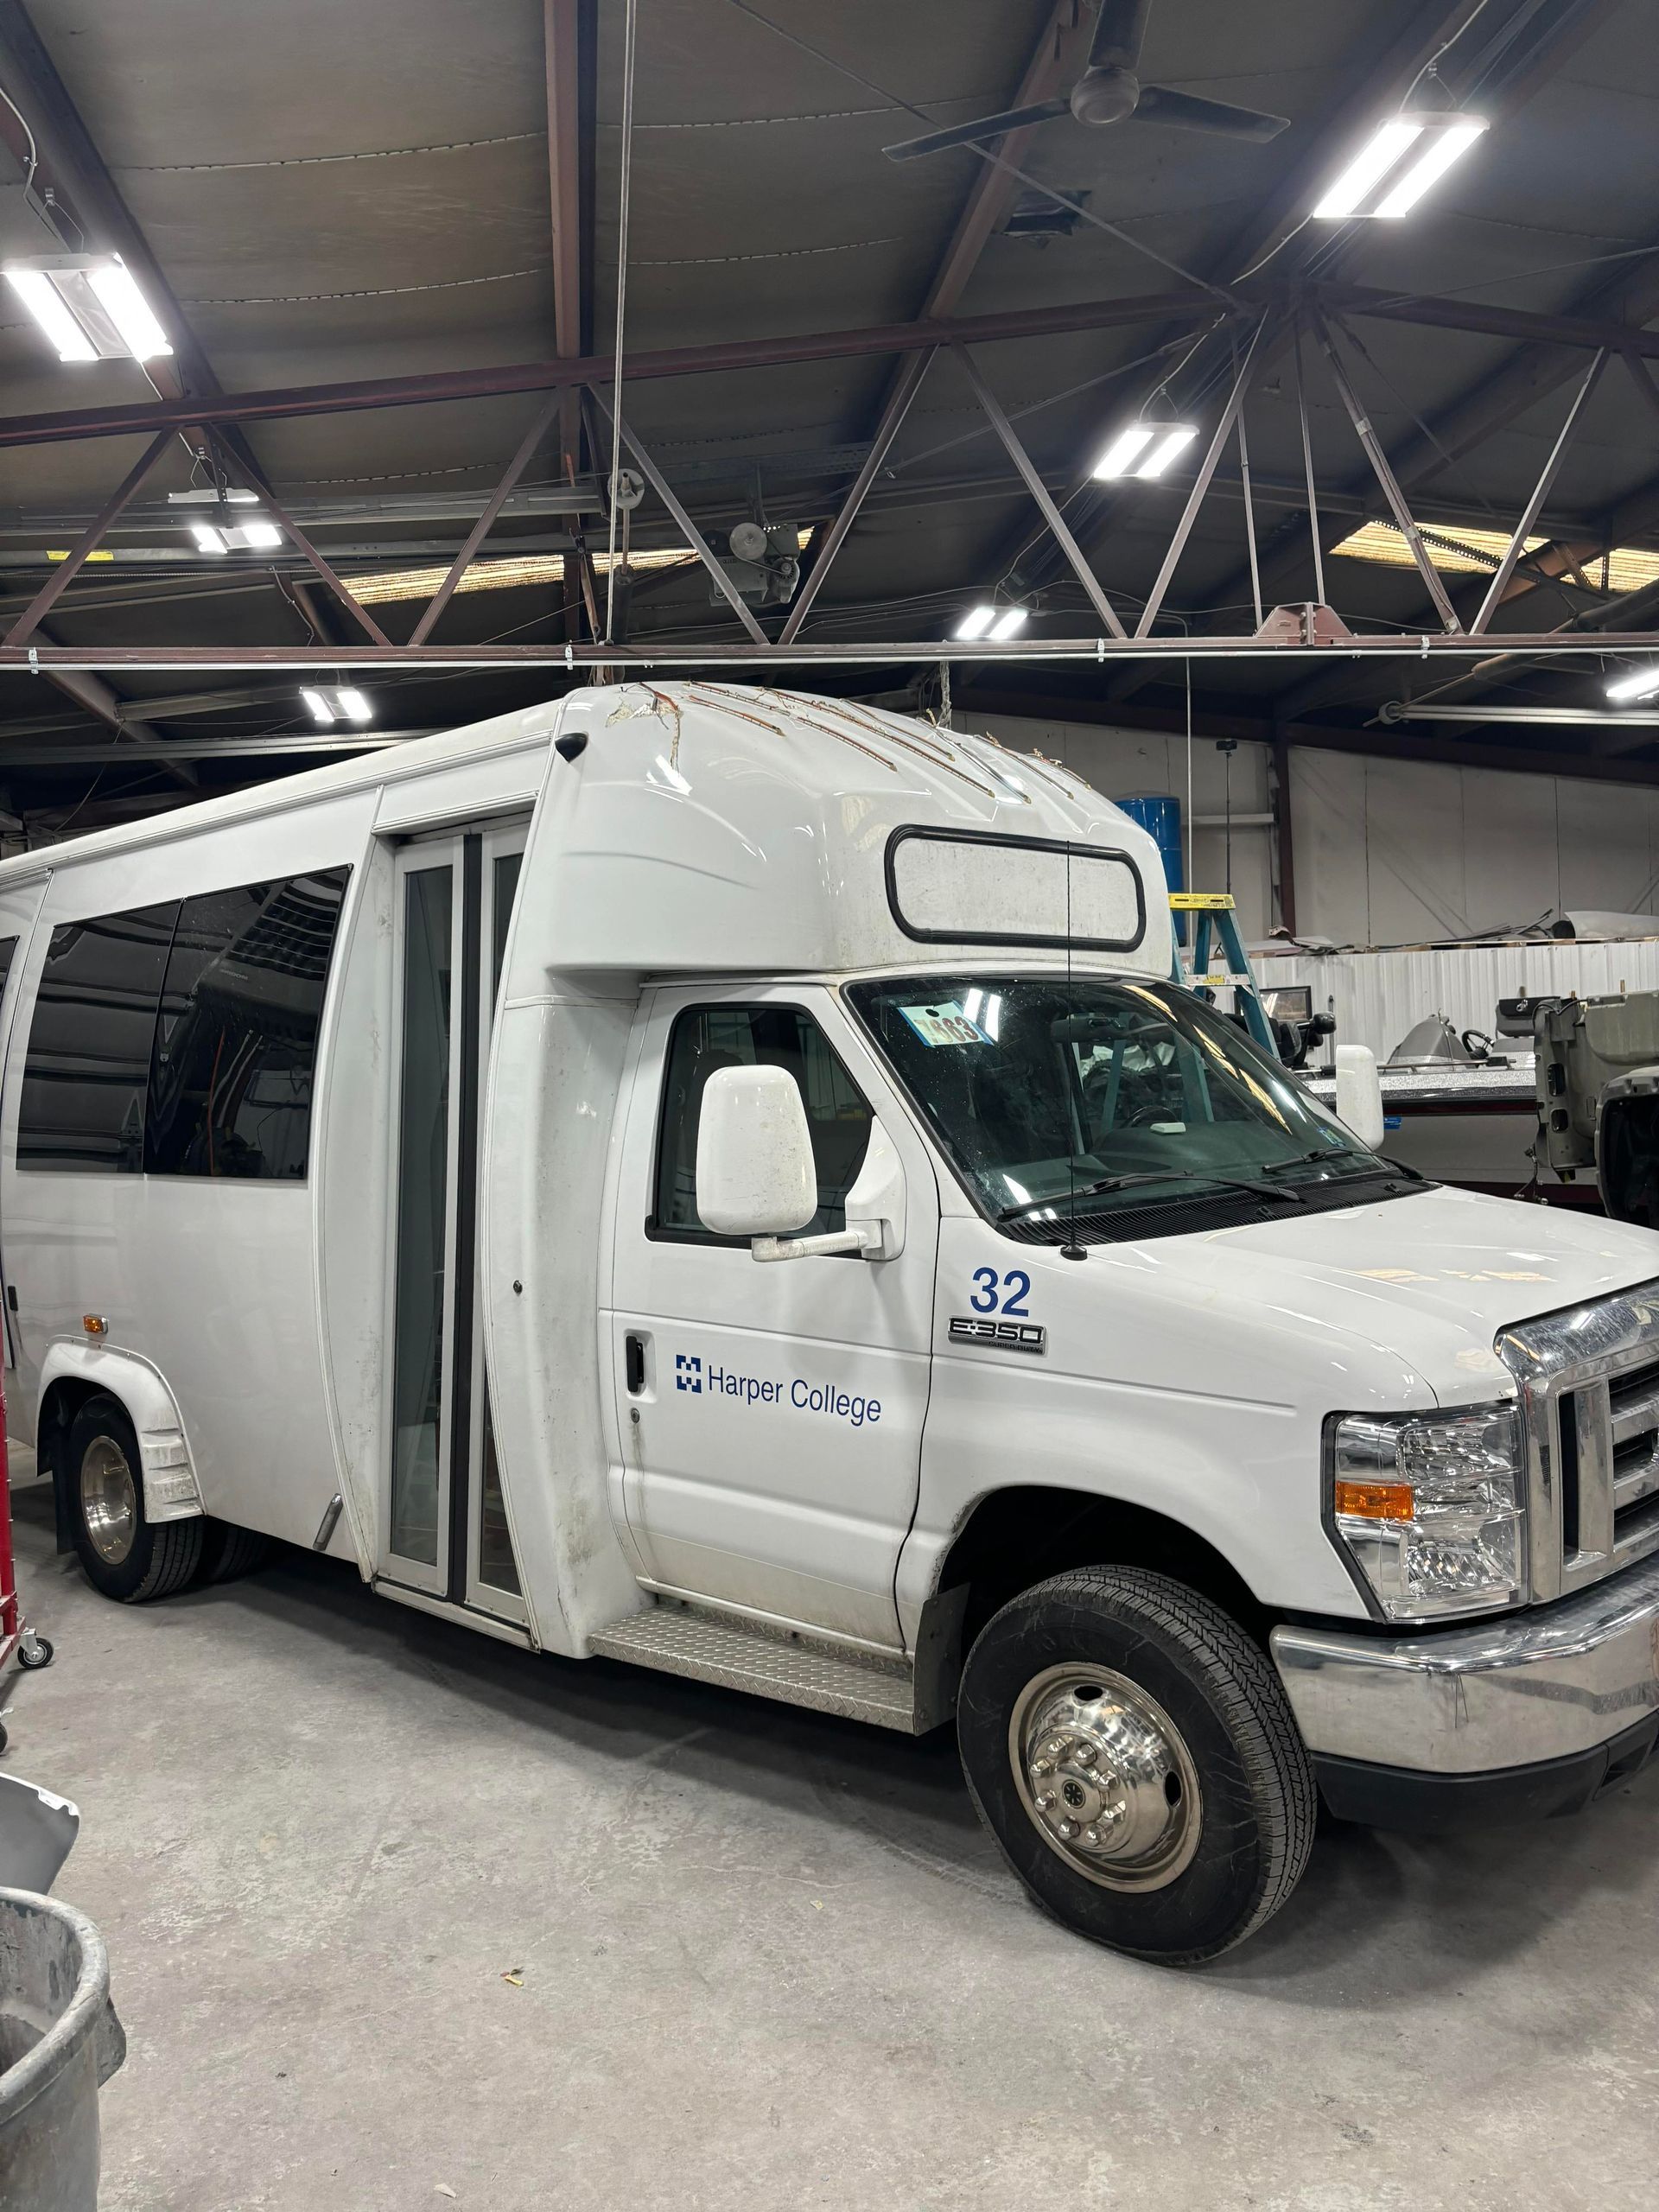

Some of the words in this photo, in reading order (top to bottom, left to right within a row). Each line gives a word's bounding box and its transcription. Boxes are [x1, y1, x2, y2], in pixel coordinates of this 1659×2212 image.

[970, 1267, 1031, 1318] 32
[709, 1365, 783, 1406] Harper
[790, 1379, 882, 1427] College
